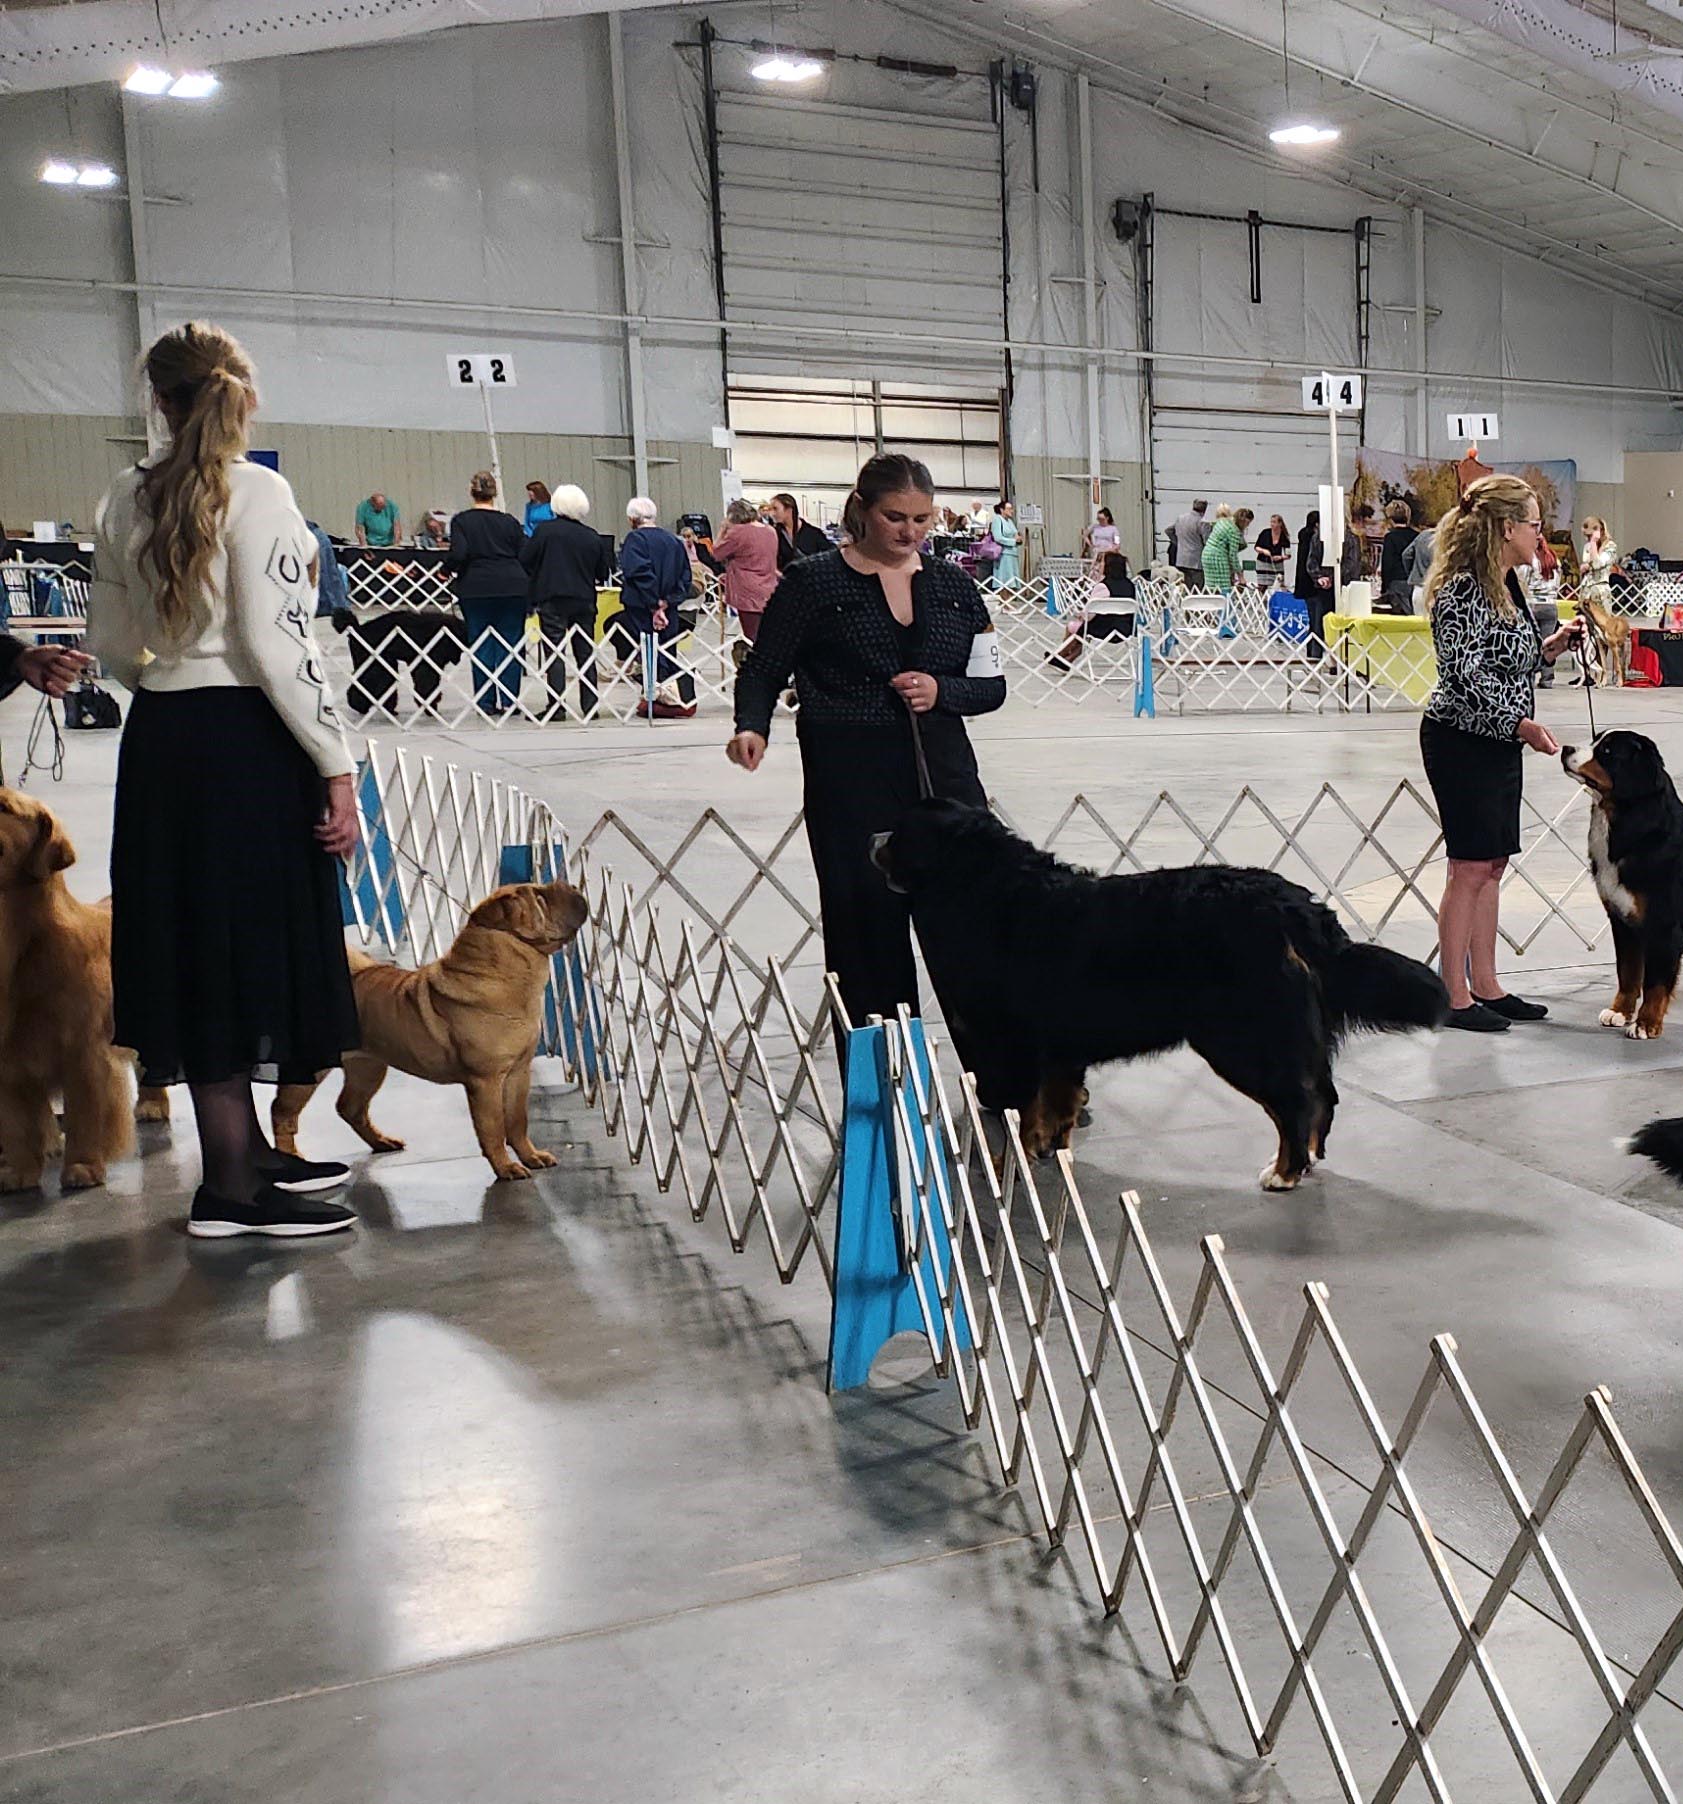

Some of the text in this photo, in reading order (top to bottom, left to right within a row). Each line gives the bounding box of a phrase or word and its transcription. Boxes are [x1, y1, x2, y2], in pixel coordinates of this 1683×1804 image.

[458, 359, 506, 383] 2 2
[1312, 381, 1352, 405] 4 4
[1458, 418, 1488, 436] 1 1
